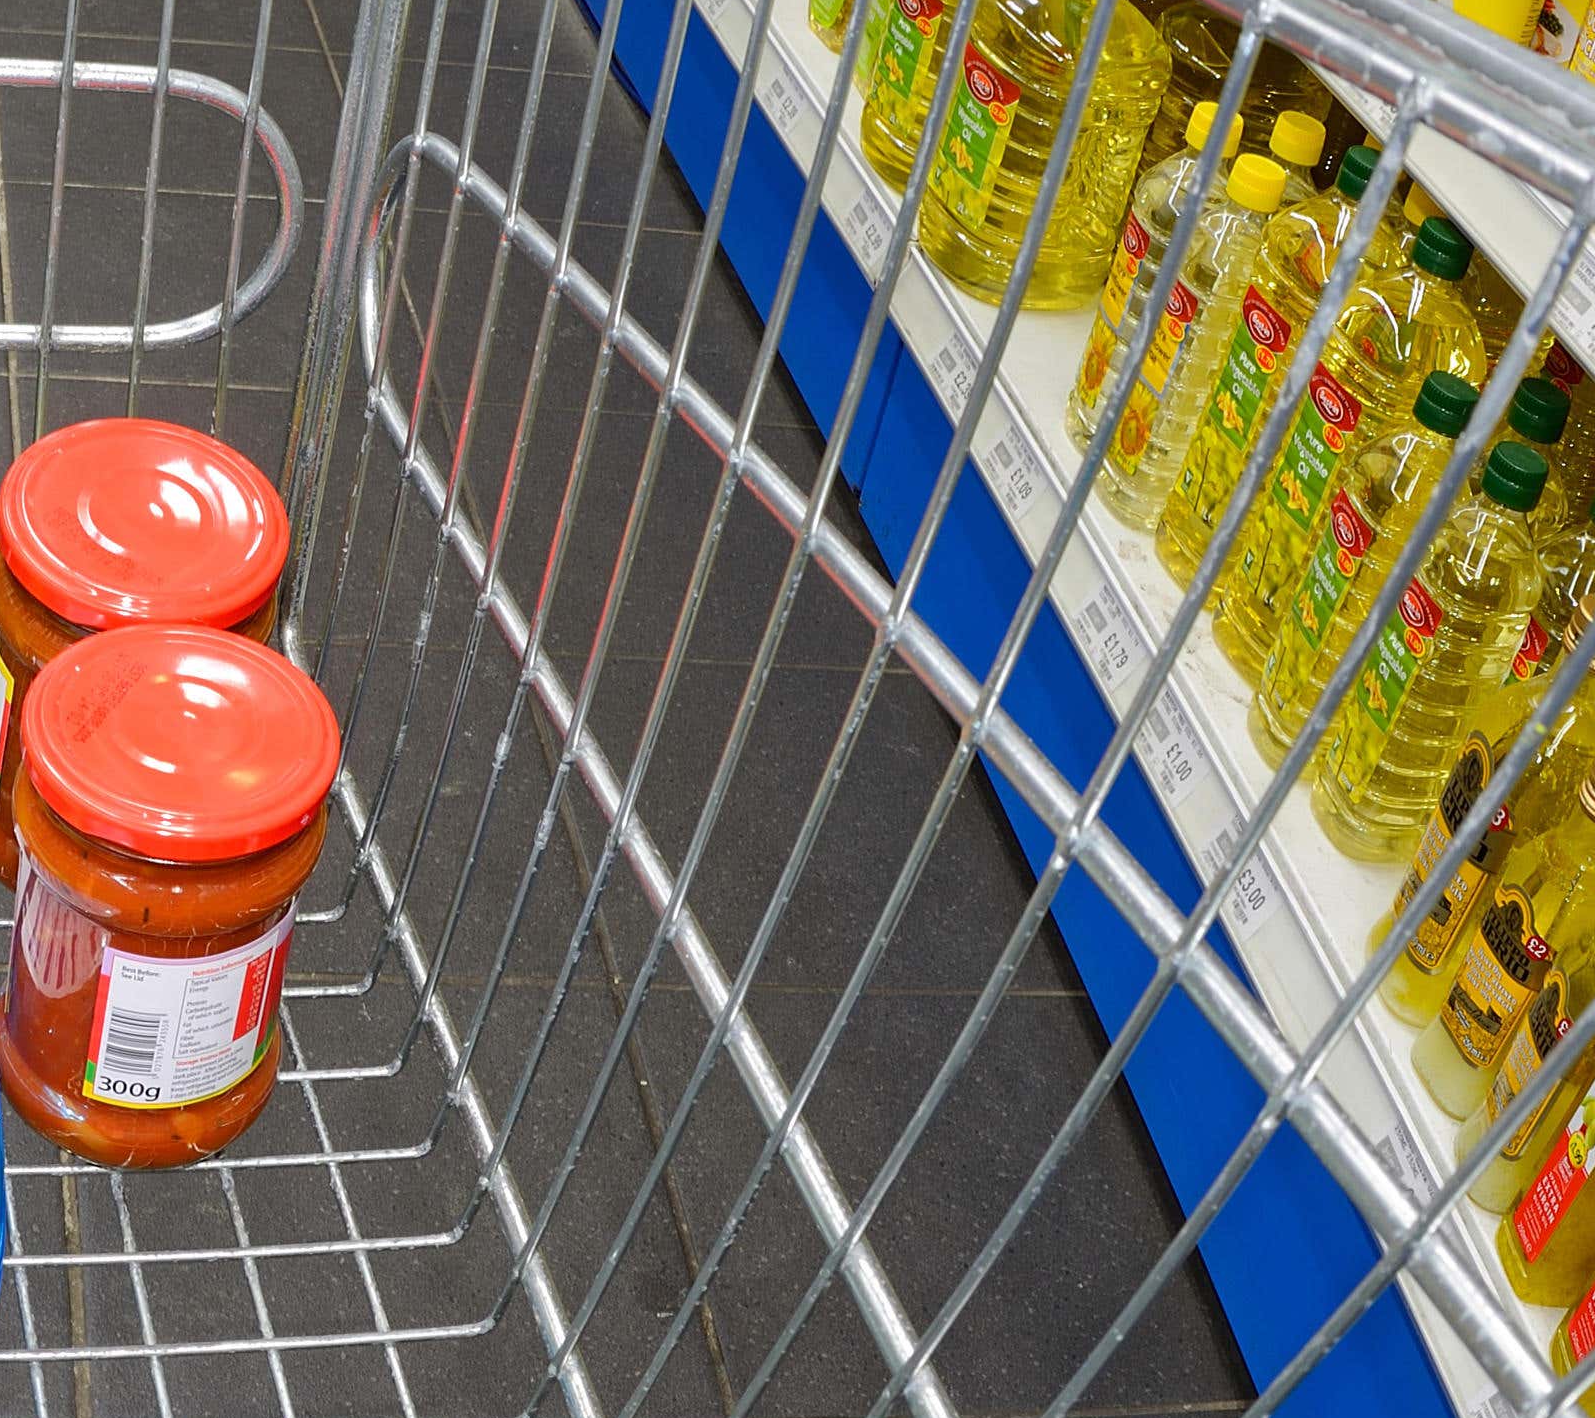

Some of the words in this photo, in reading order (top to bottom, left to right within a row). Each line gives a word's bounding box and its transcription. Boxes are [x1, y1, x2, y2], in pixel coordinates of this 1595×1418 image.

[1228, 355, 1261, 398] Vegetable
[1239, 350, 1257, 375] Pure
[1305, 430, 1325, 454] Pure
[1011, 468, 1032, 502] £1.09
[1104, 633, 1129, 669] £1.79
[1378, 662, 1390, 680] Oil
[137, 968, 160, 976] Before:
[98, 1076, 161, 1102] 300g
[1536, 1183, 1554, 1225] VIRGIN
[1541, 1175, 1559, 1213] EXTRA
